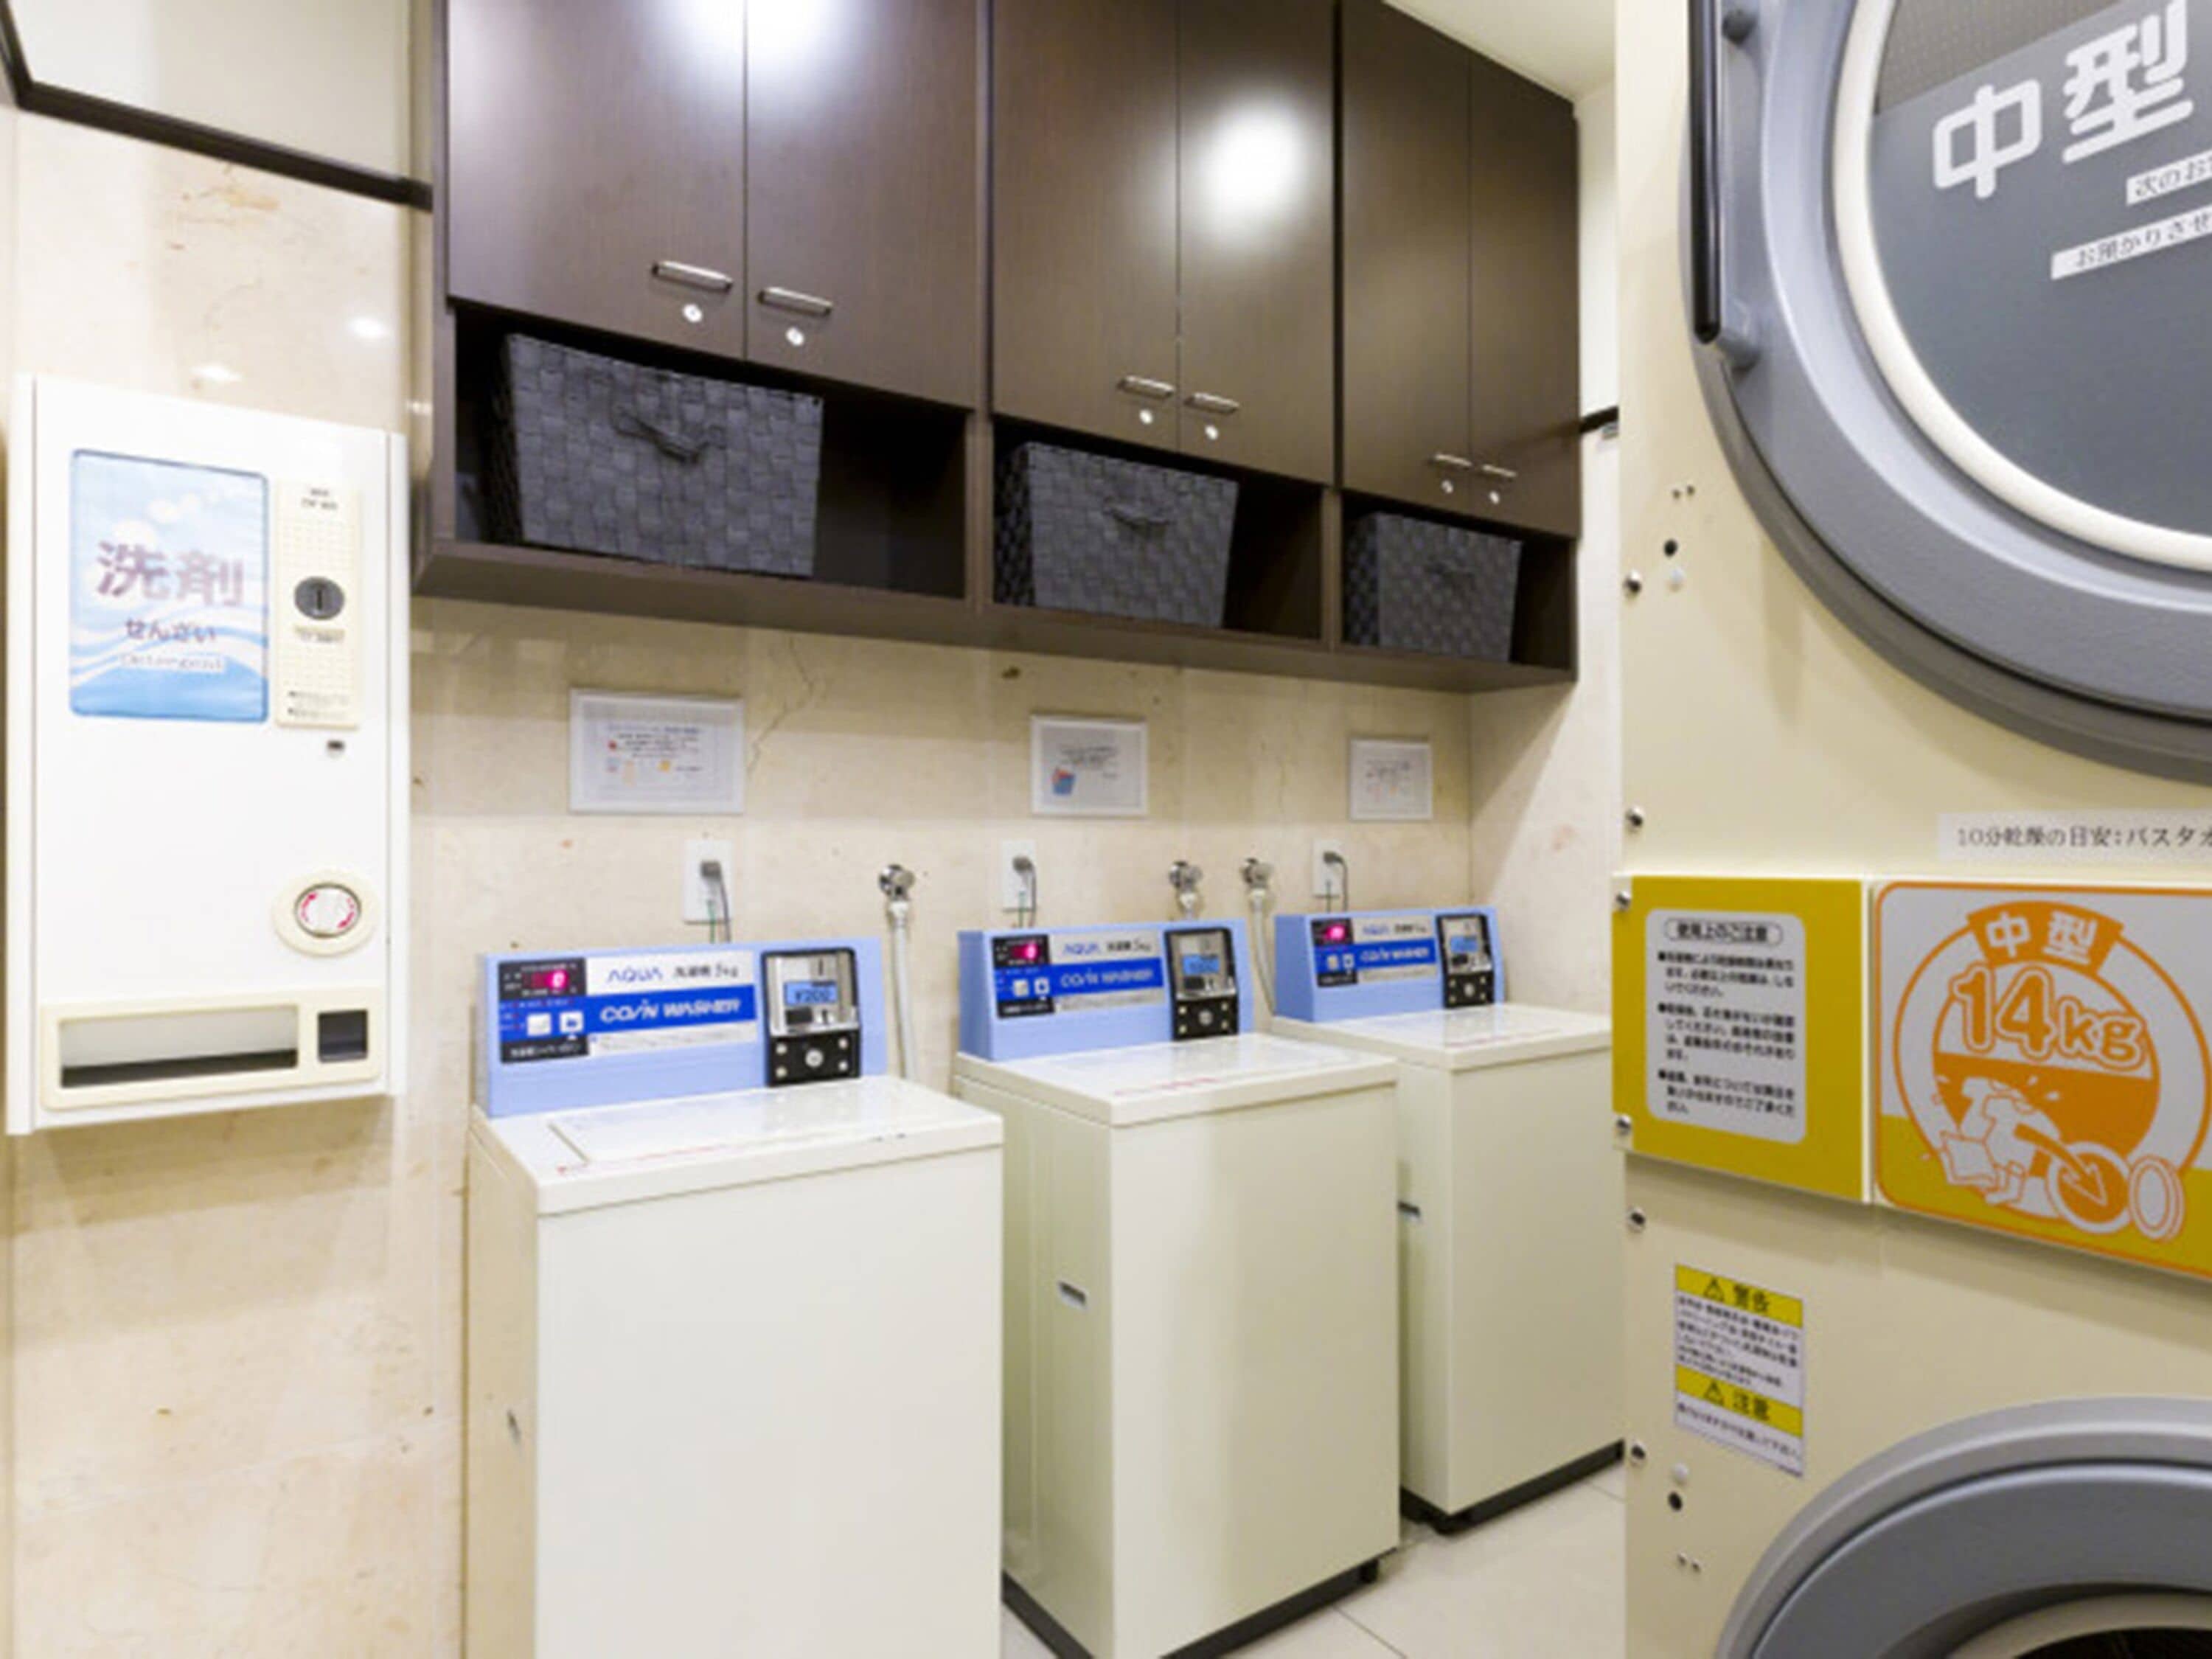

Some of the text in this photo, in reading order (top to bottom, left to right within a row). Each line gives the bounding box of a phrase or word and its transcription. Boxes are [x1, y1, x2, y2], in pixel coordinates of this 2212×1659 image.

[1933, 0, 2194, 199] 中型
[2135, 155, 2212, 196] 次のお
[97, 540, 245, 607] 洗剤
[1986, 910, 2098, 965] 中型
[663, 998, 741, 1018] WASHER
[1952, 965, 2145, 1068] 14kg
